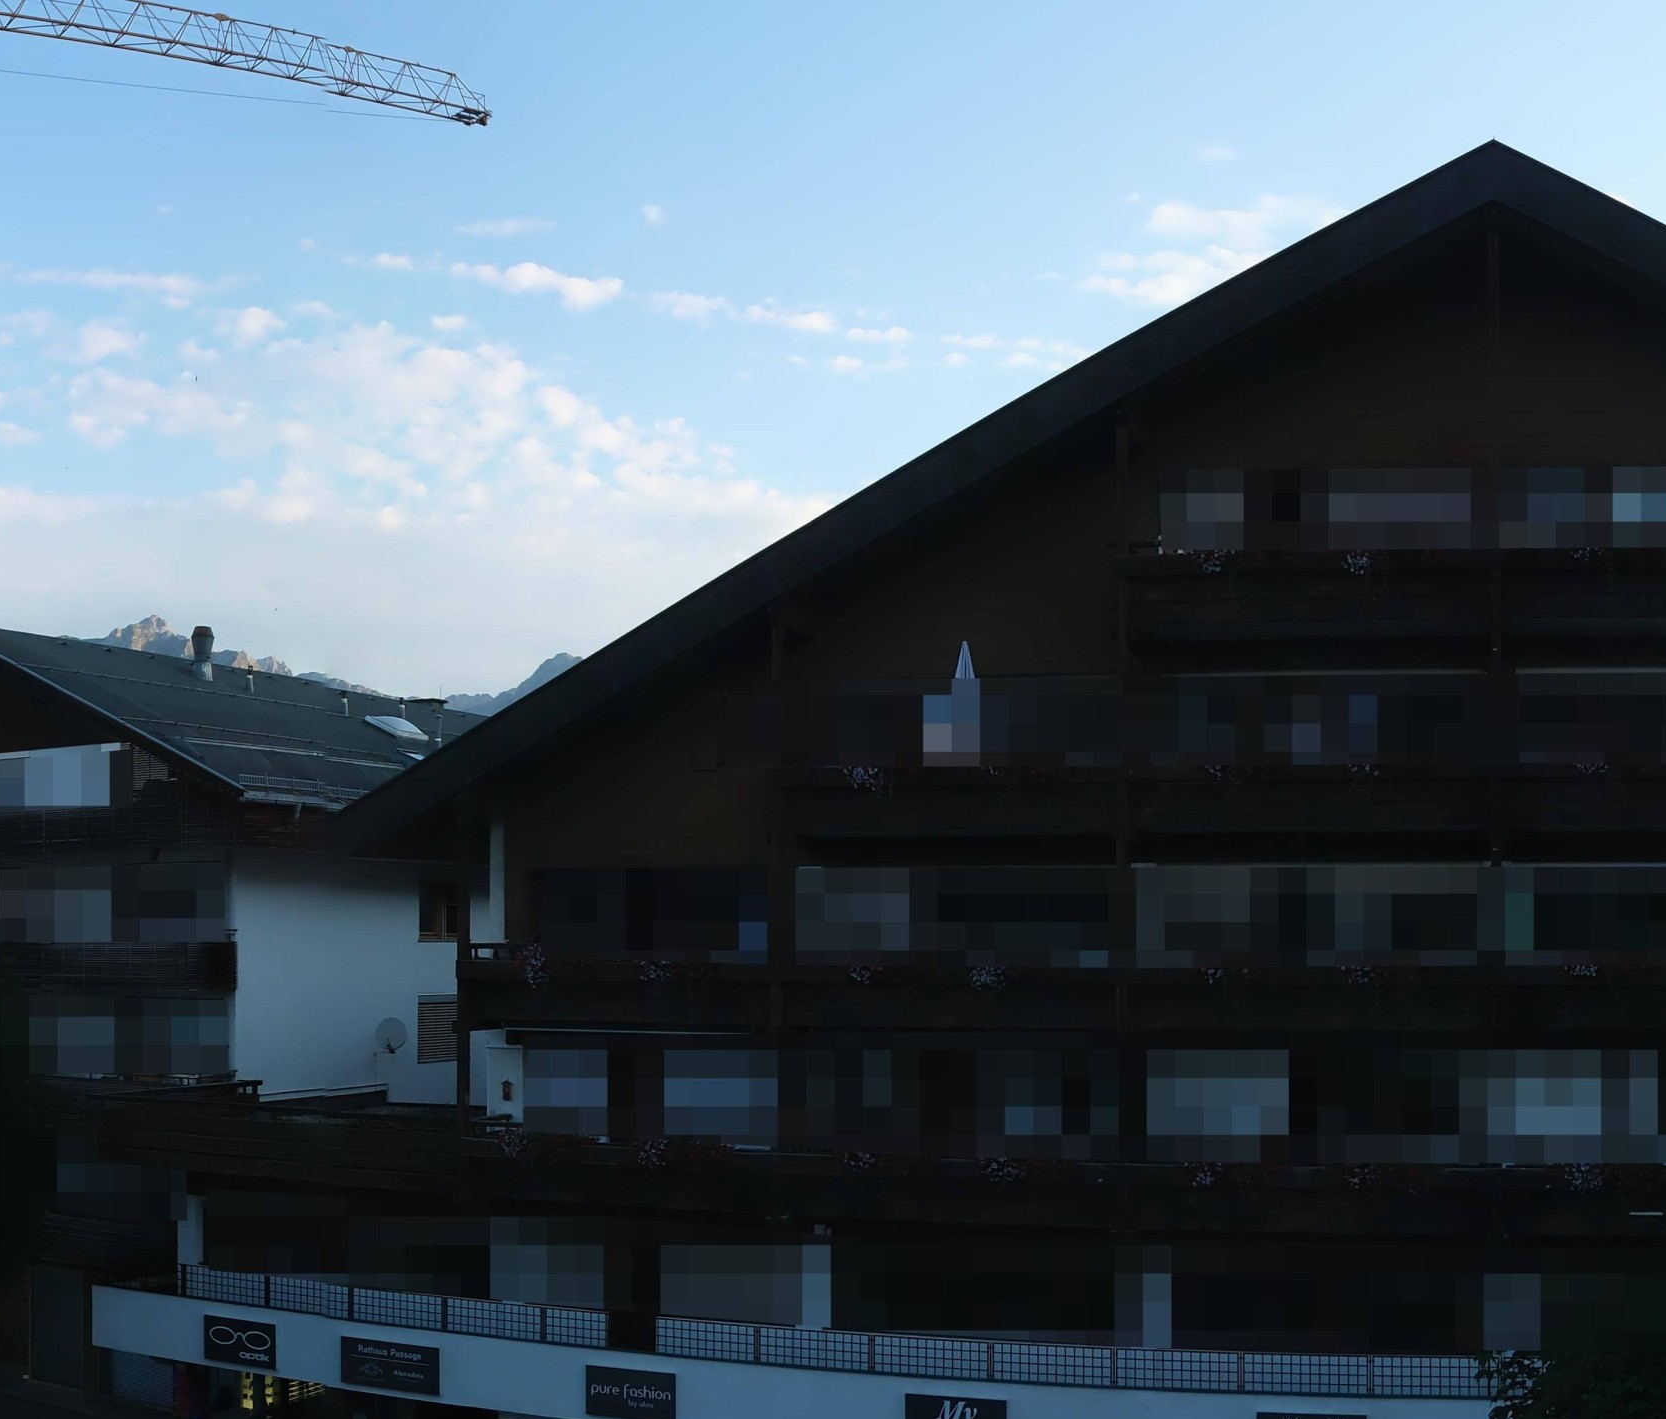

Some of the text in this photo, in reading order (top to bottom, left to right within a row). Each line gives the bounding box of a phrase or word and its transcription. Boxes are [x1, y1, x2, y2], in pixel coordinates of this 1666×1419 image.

[238, 1351, 270, 1362] optik
[358, 1344, 422, 1361] Rathaus Passage
[590, 1383, 671, 1401] pure fashion
[628, 1399, 637, 1409] by
